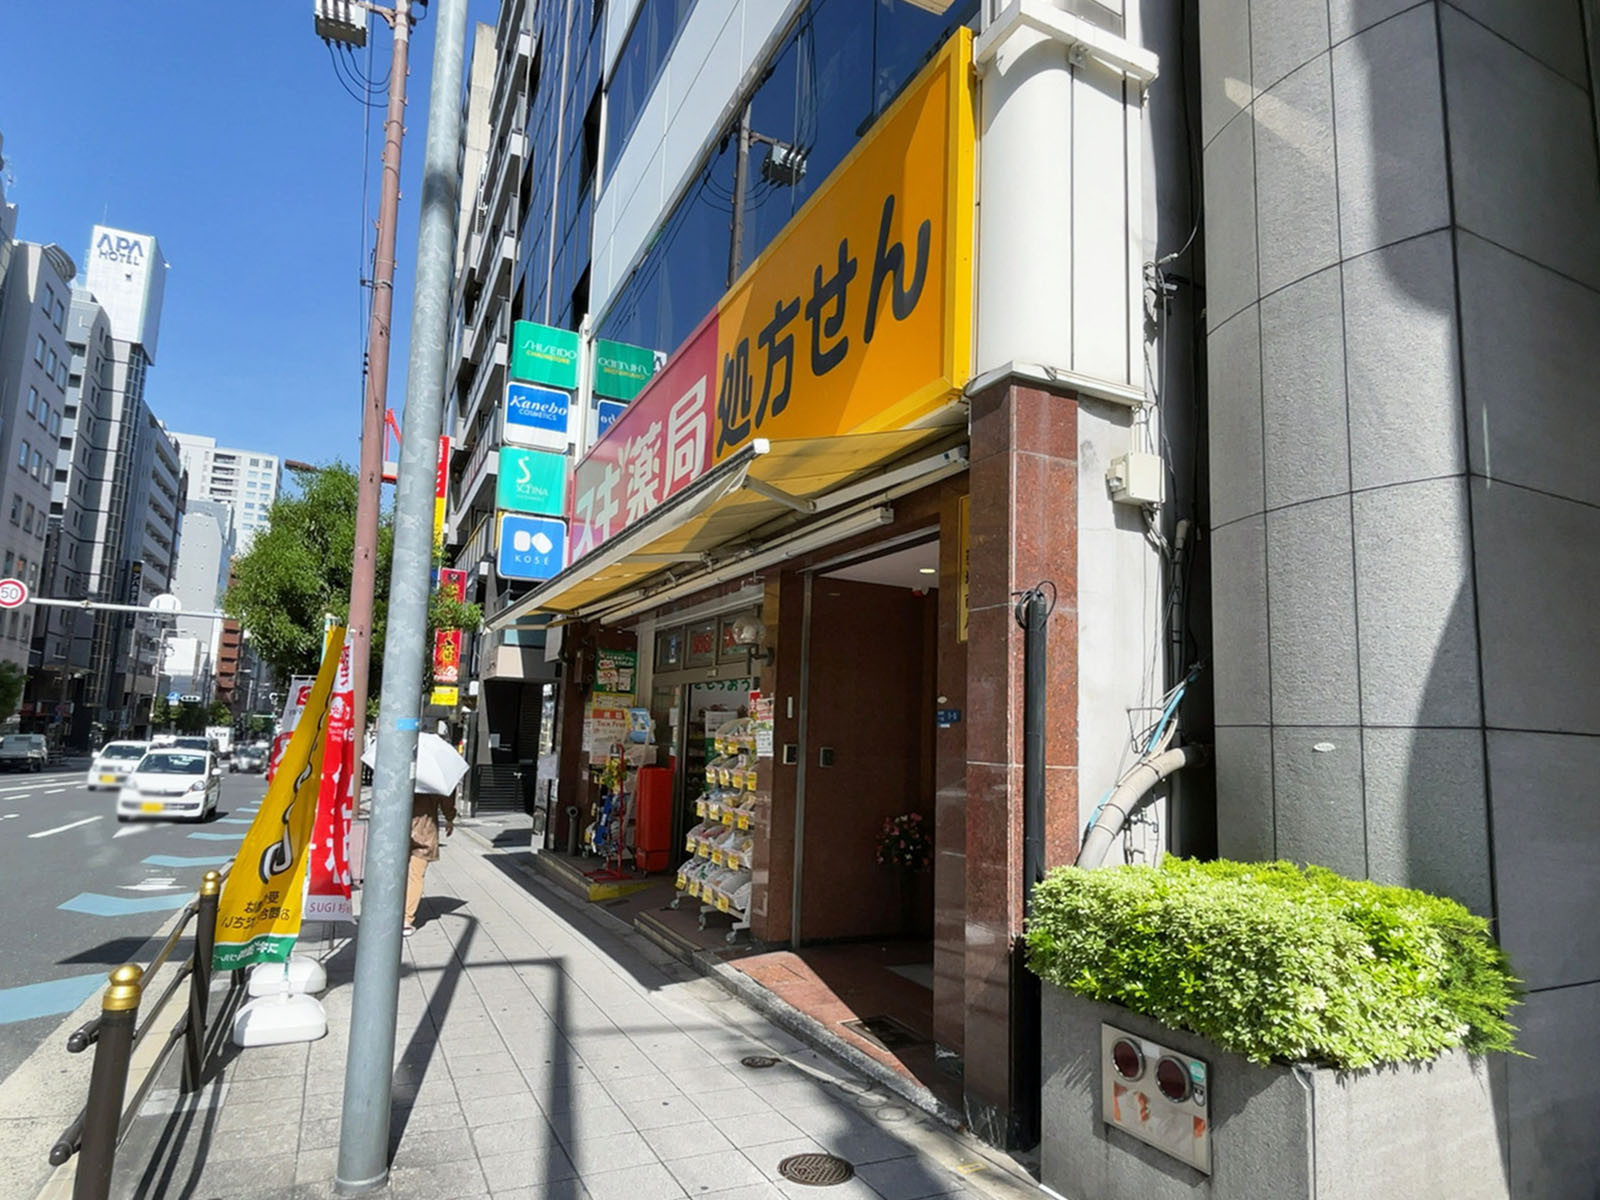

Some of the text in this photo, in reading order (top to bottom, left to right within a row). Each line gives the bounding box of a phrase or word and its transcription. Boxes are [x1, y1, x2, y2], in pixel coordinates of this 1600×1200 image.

[96, 233, 144, 257] APA
[98, 248, 139, 266] HOTEL
[715, 193, 931, 458] 処方せん
[521, 339, 577, 359] SHISEIDO
[509, 394, 568, 416] Kanebo
[572, 374, 707, 566] スギ薬局
[1, 588, 19, 600] 50
[310, 902, 336, 912] SUGI
